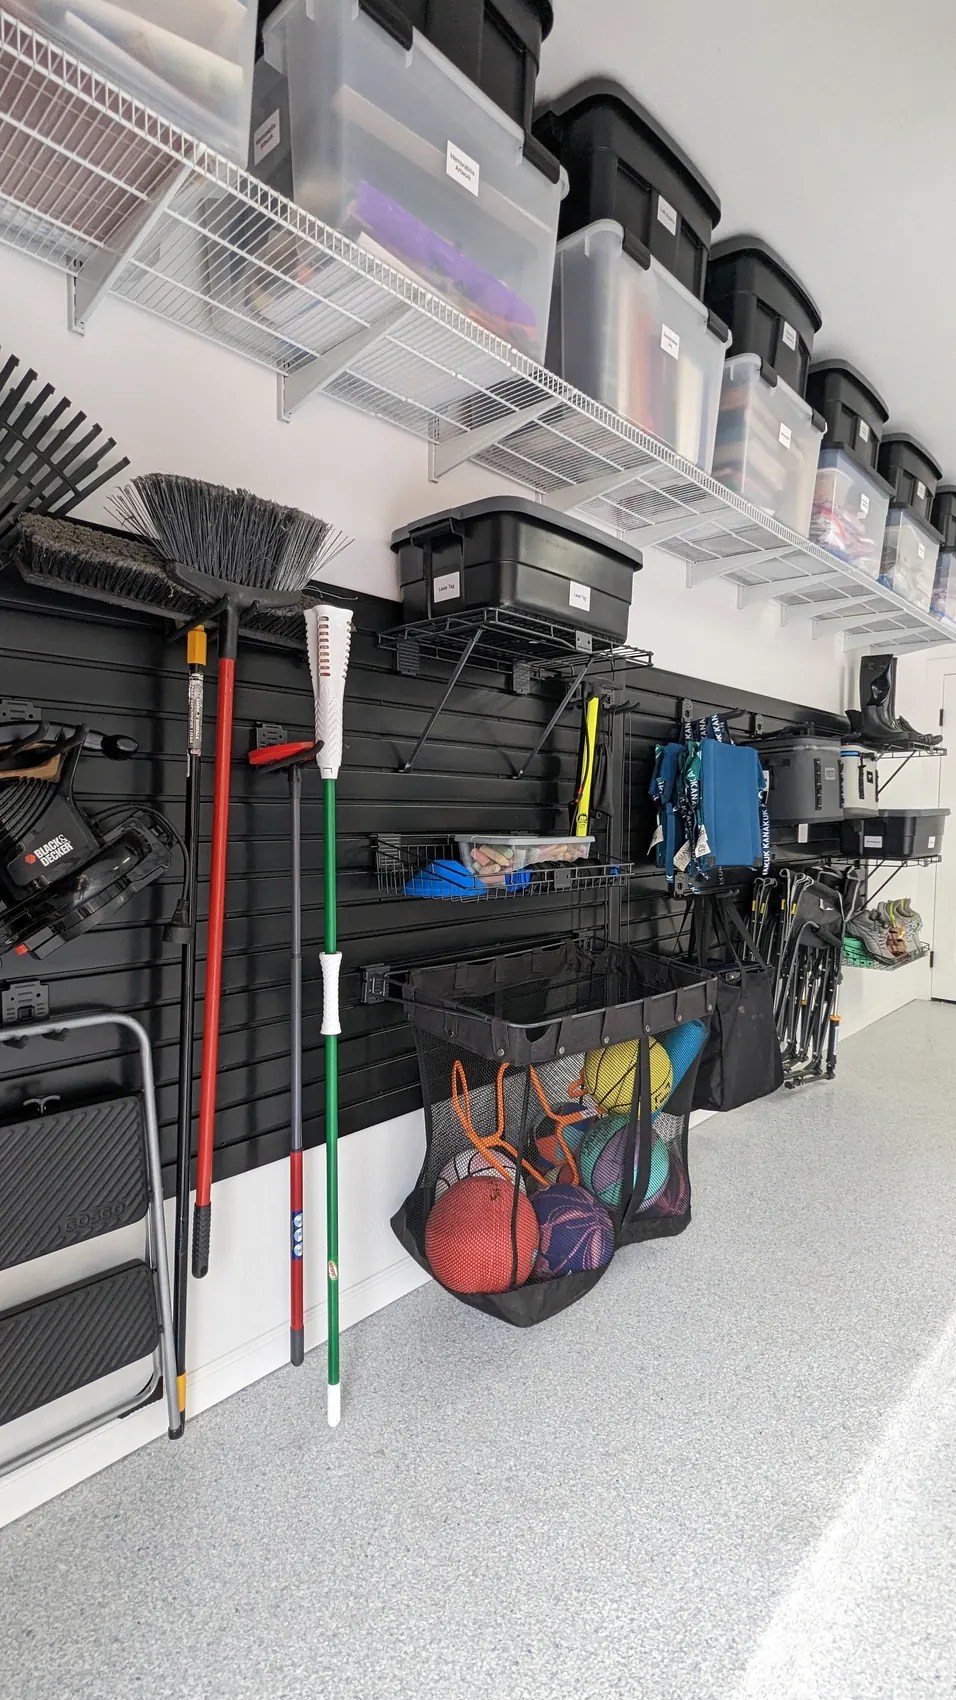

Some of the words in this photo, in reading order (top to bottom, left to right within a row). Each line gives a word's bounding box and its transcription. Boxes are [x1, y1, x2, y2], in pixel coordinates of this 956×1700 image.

[449, 152, 475, 177] Memorabilia
[455, 165, 472, 181] Artwork
[762, 808, 770, 849] KANAKUK
[33, 834, 69, 859] BLACK&
[40, 842, 74, 867] DECKER
[65, 1202, 124, 1232] COSCO
